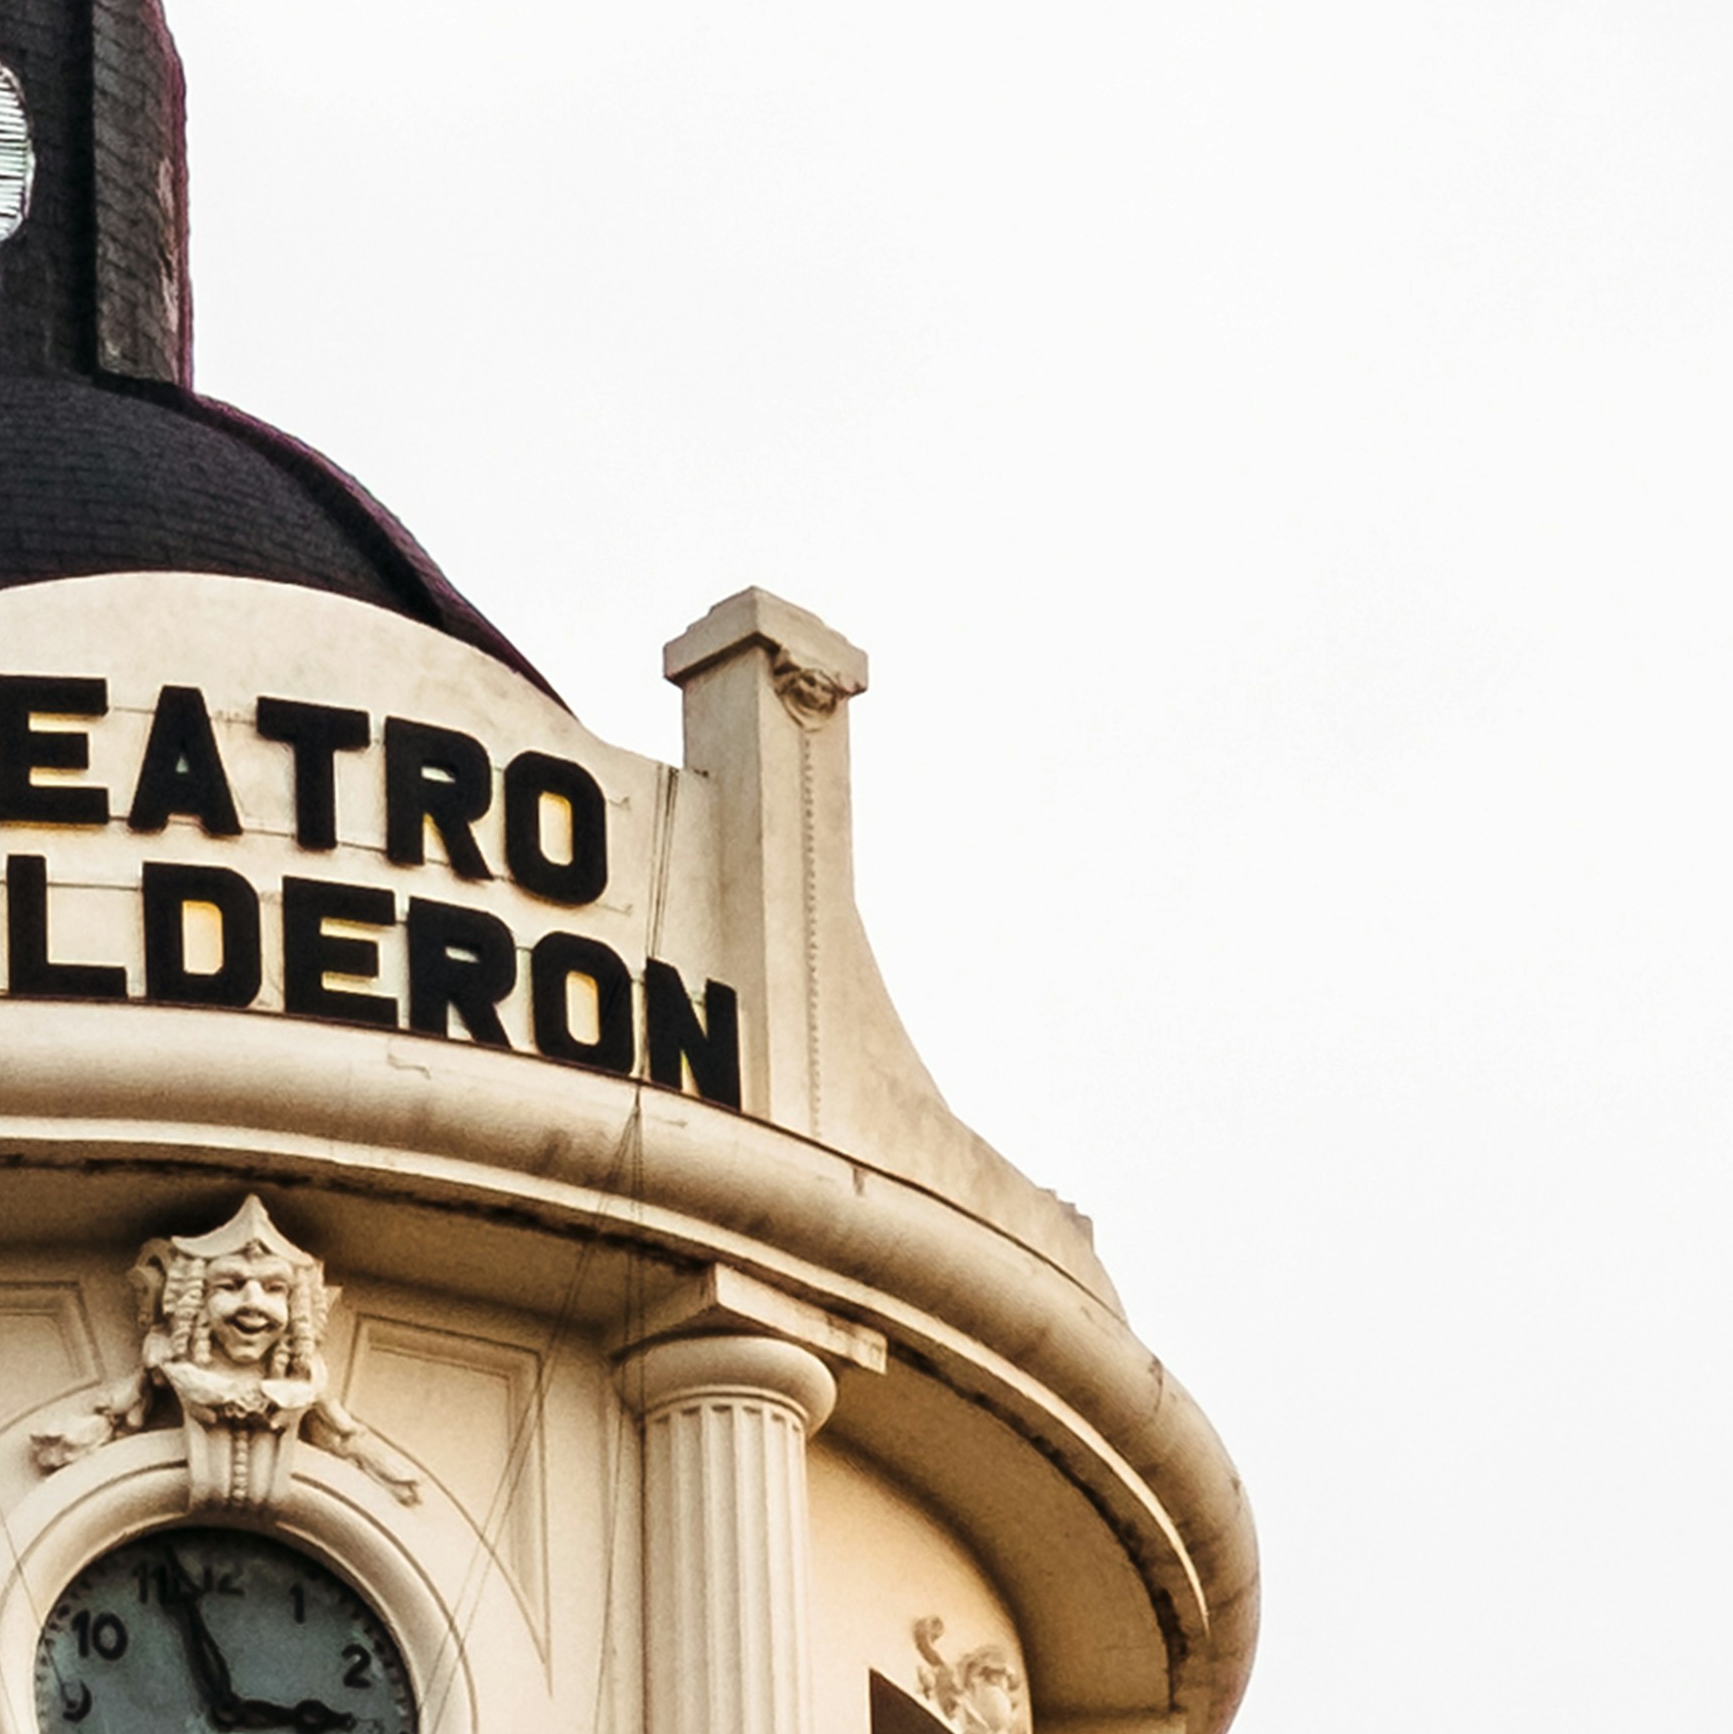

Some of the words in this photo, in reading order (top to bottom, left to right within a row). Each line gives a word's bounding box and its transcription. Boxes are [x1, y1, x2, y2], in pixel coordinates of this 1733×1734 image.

[289, 1583, 306, 1624] 1
[71, 1609, 128, 1660] 10
[341, 1643, 372, 1689] 2
